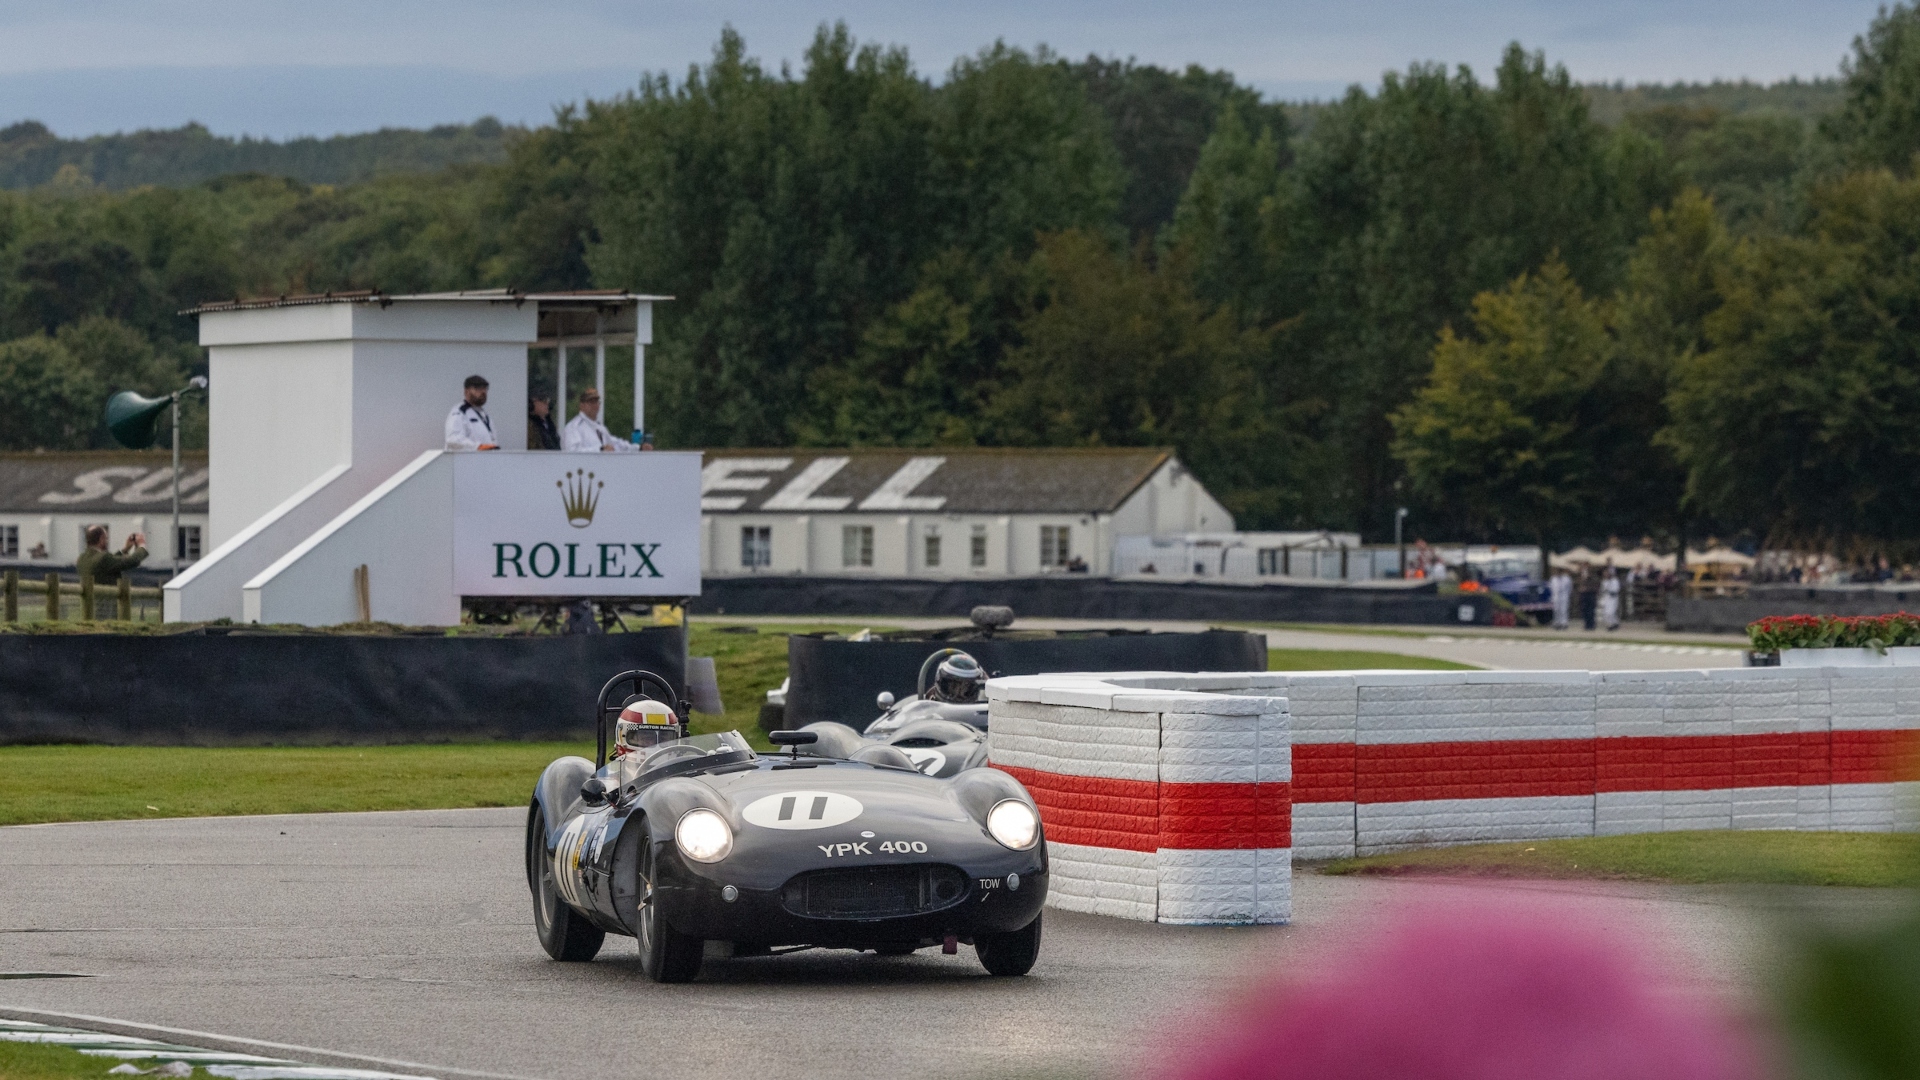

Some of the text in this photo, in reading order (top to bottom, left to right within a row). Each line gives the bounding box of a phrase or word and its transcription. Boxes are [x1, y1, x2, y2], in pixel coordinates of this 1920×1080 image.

[38, 466, 209, 504] SU
[492, 542, 664, 578] ROLEX
[778, 796, 828, 821] 11
[818, 841, 928, 858] YPK 400
[979, 878, 1000, 890] TOW
